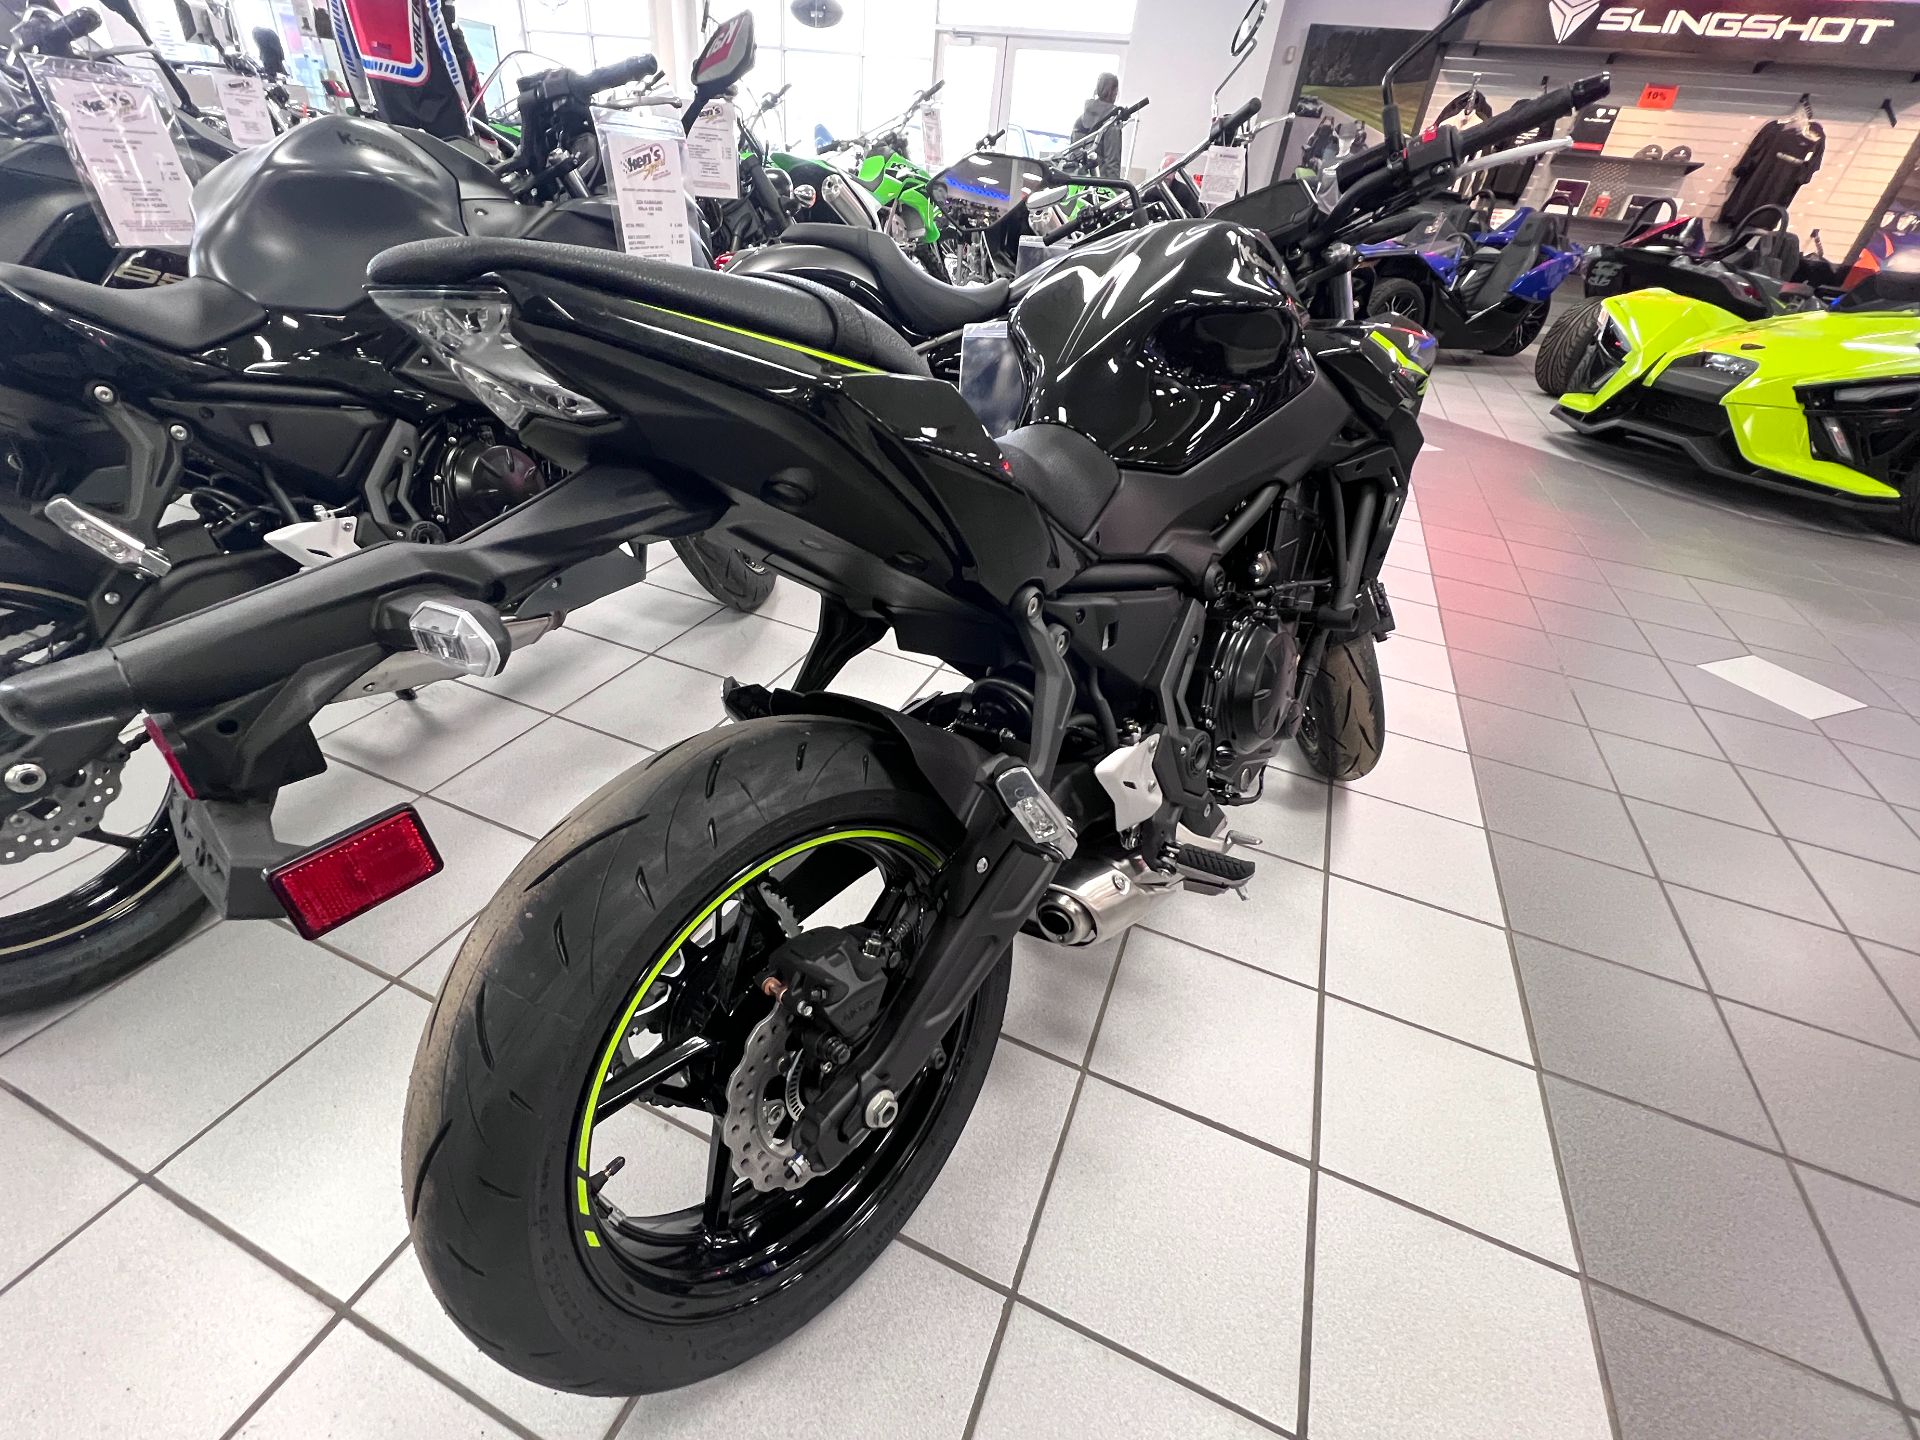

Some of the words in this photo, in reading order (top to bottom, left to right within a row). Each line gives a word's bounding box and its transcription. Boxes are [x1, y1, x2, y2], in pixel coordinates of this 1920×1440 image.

[1597, 7, 1894, 44] SLINGSHOT
[1647, 91, 1668, 101] 10%
[890, 162, 920, 174] KX
